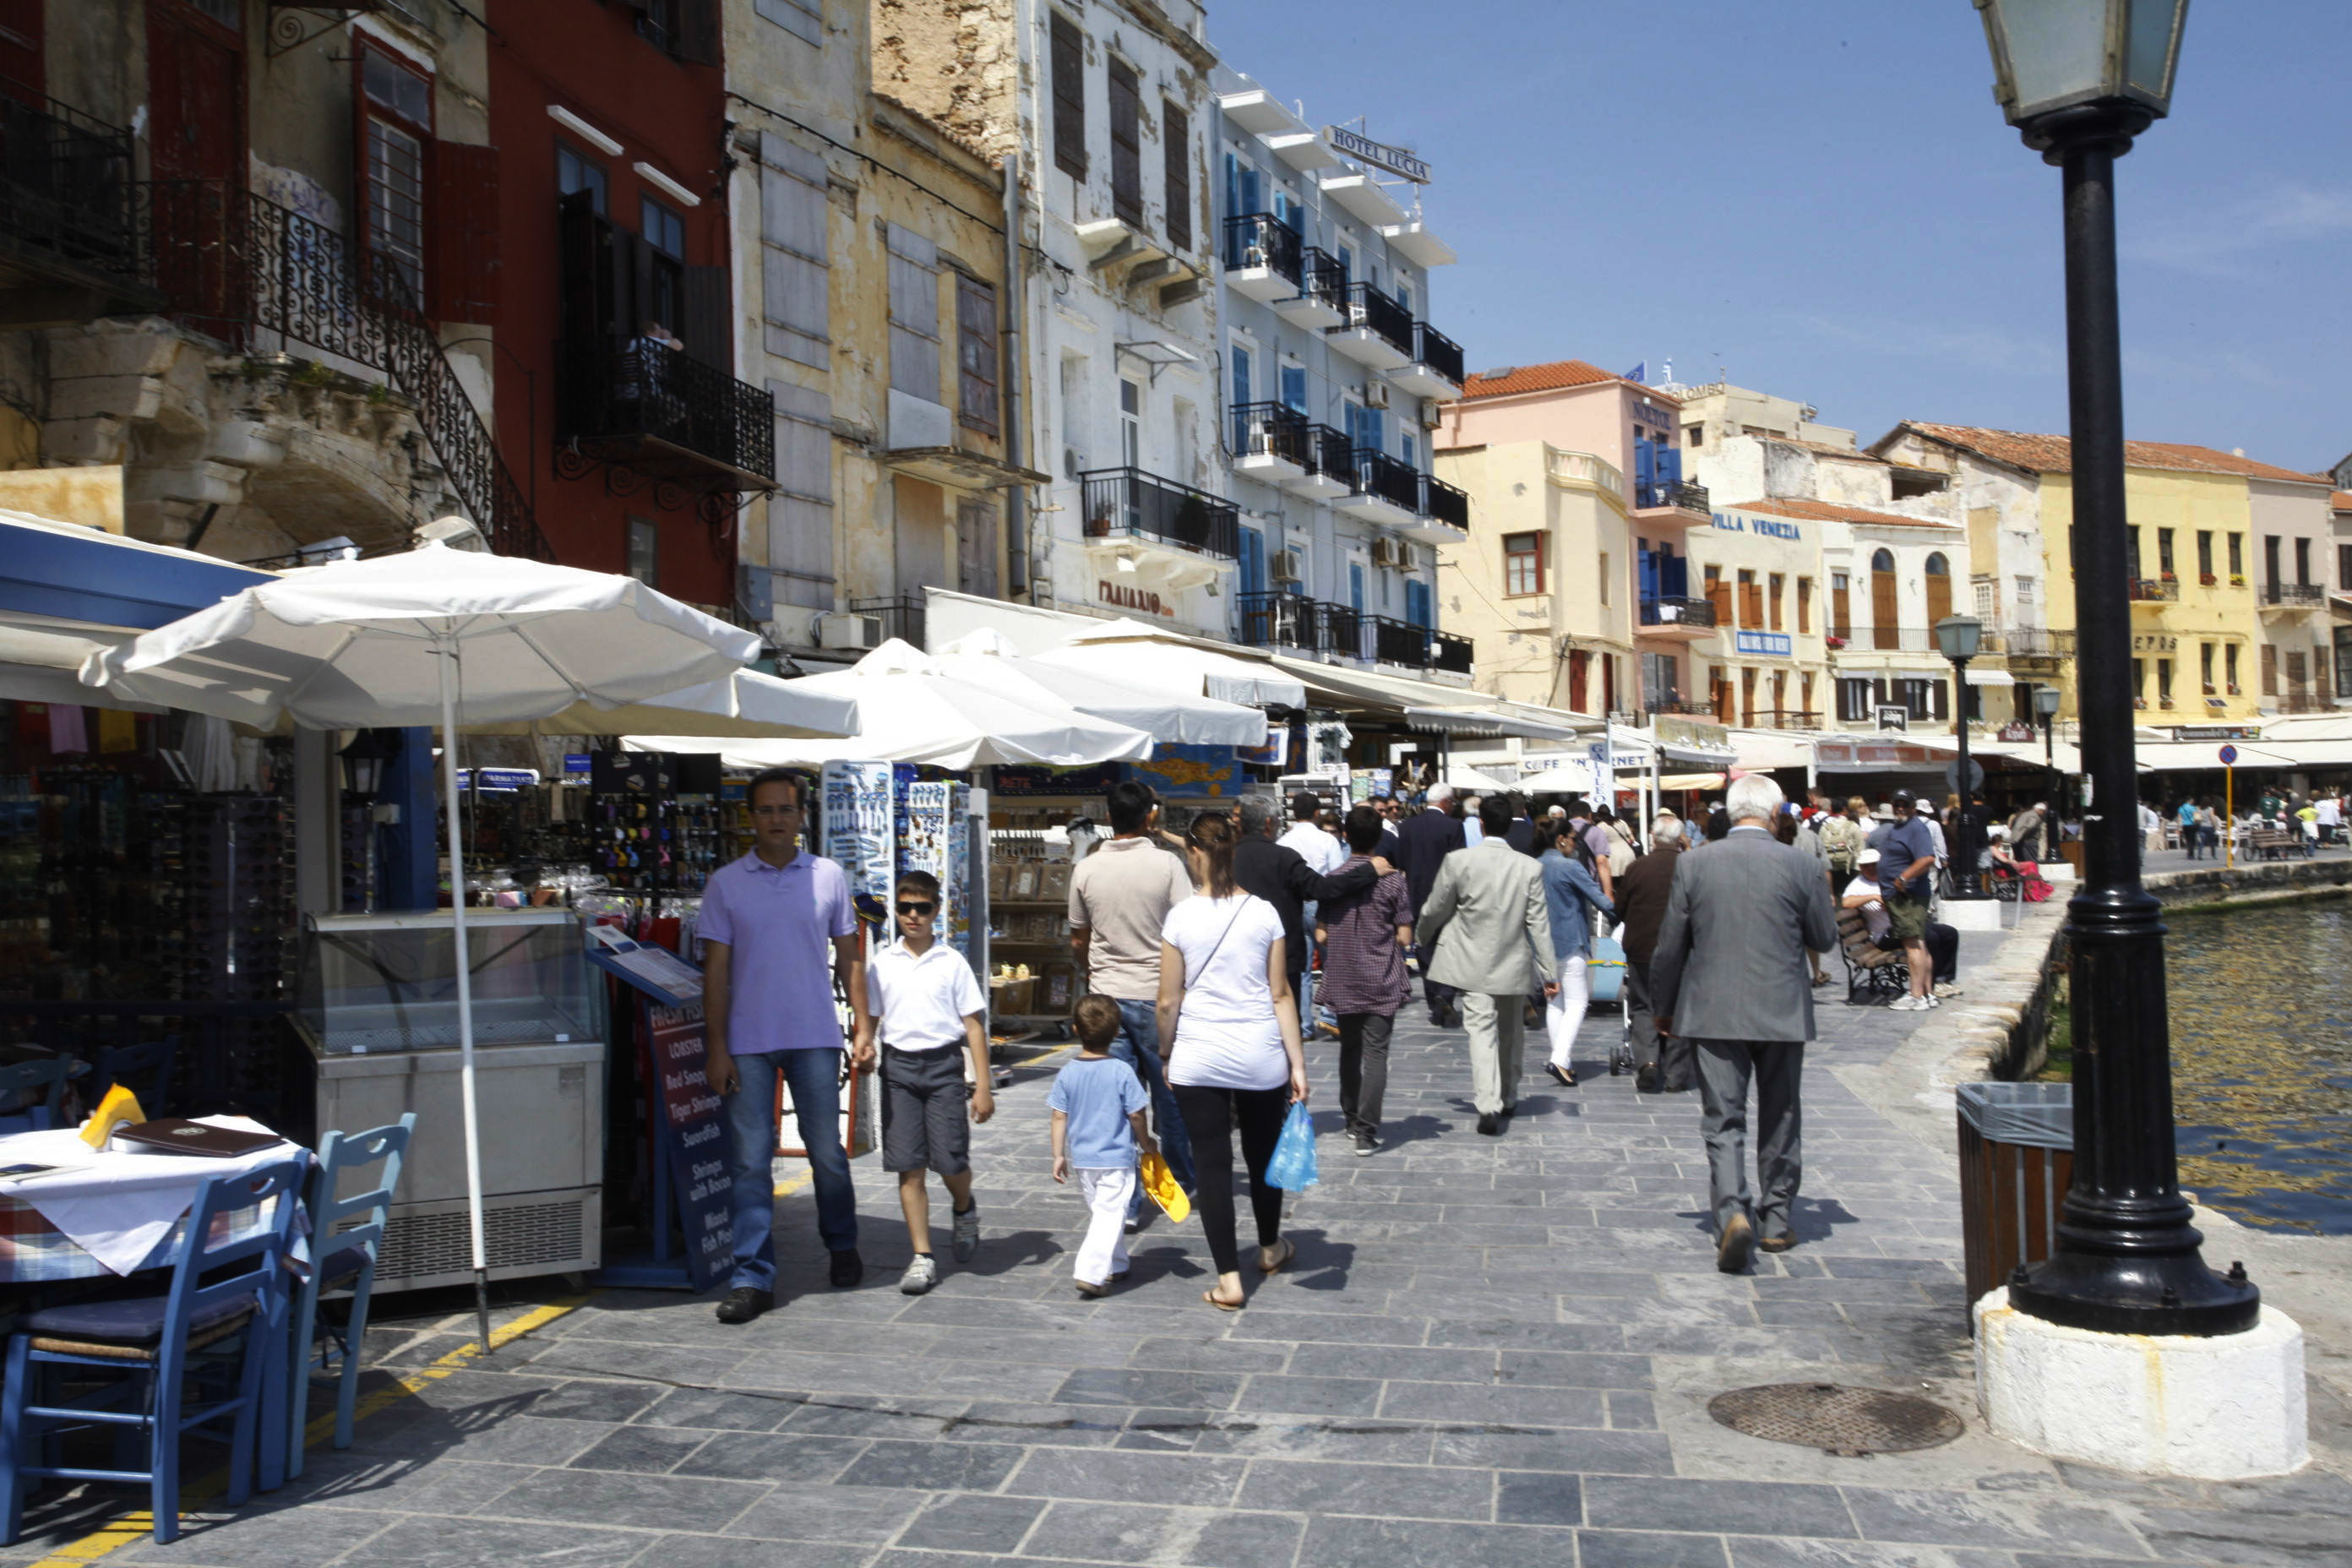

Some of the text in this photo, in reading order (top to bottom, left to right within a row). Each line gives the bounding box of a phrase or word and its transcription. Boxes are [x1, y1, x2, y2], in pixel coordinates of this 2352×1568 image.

[1334, 129, 1427, 179] HOTEL LUCIA
[1712, 514, 1800, 540] VILLA VENEZIA
[668, 1037, 704, 1059] LOBSTER
